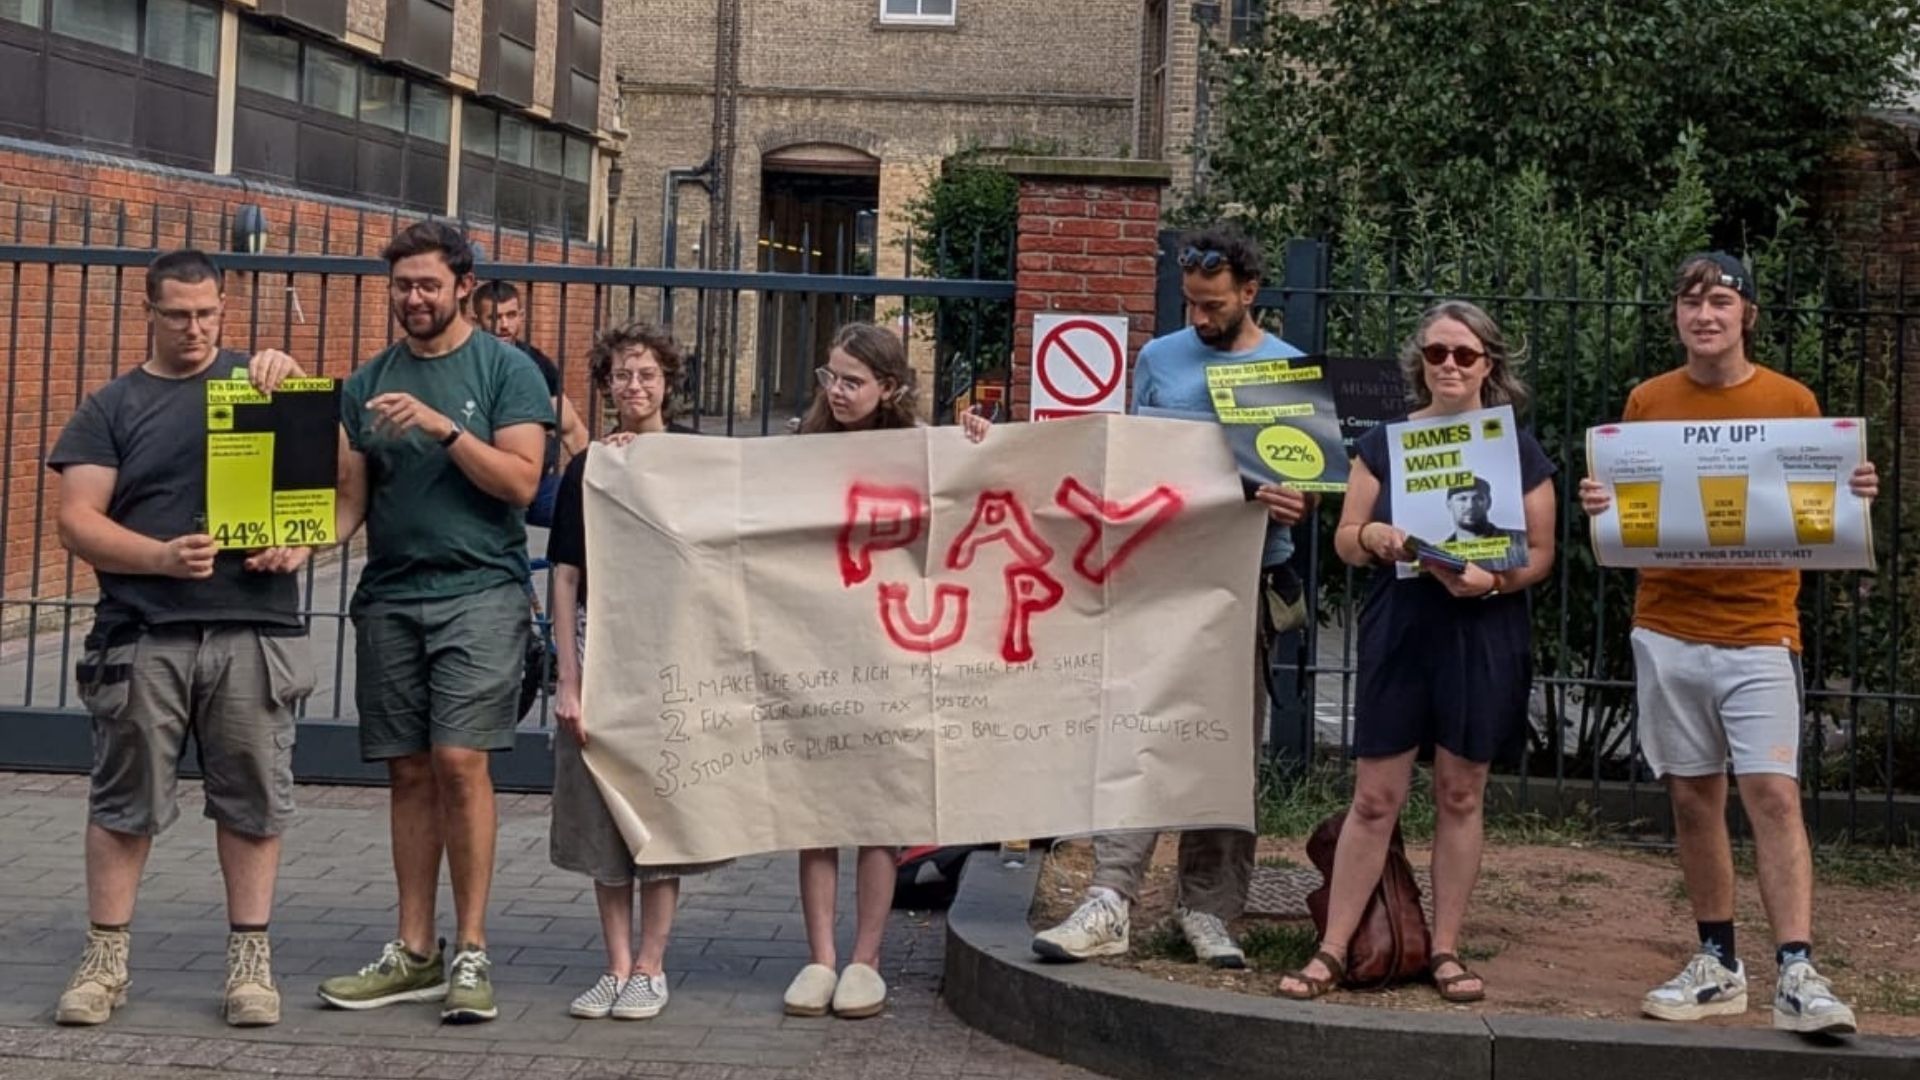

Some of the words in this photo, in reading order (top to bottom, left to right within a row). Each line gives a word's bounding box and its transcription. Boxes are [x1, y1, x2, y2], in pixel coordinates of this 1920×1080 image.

[1404, 425, 1471, 450] JAMES
[1684, 426, 1721, 443] PAY
[1730, 425, 1765, 442] UP!
[1266, 444, 1315, 464] 22%
[1405, 450, 1461, 472] WATT
[1406, 475, 1443, 492] PAY
[1445, 471, 1473, 488] UP
[215, 522, 269, 547] 44%
[284, 518, 327, 543] 21%
[837, 475, 1183, 588] PAY
[877, 563, 1065, 664] UP
[659, 664, 694, 704] 1.
[698, 674, 753, 698] MAKE
[762, 672, 789, 692] THE
[798, 669, 840, 690] SUPER
[852, 665, 890, 684] RICH
[911, 663, 943, 681] PAY
[956, 662, 999, 679] THEIR
[1006, 660, 1041, 675] FAIR
[1054, 653, 1101, 671] SHARE
[658, 708, 691, 743] 2.
[701, 708, 733, 734] FIX
[800, 699, 865, 719] RIGGED
[880, 699, 912, 713] TAX
[655, 748, 687, 799] 3.
[690, 752, 734, 785] STOP
[741, 738, 796, 766] USING
[863, 728, 926, 747] MONEY
[941, 724, 963, 741] TO
[972, 721, 1009, 738] BAIL
[1012, 722, 1051, 741] OUT
[1066, 721, 1096, 737] BIG
[1112, 713, 1230, 743] POLLUTERS
